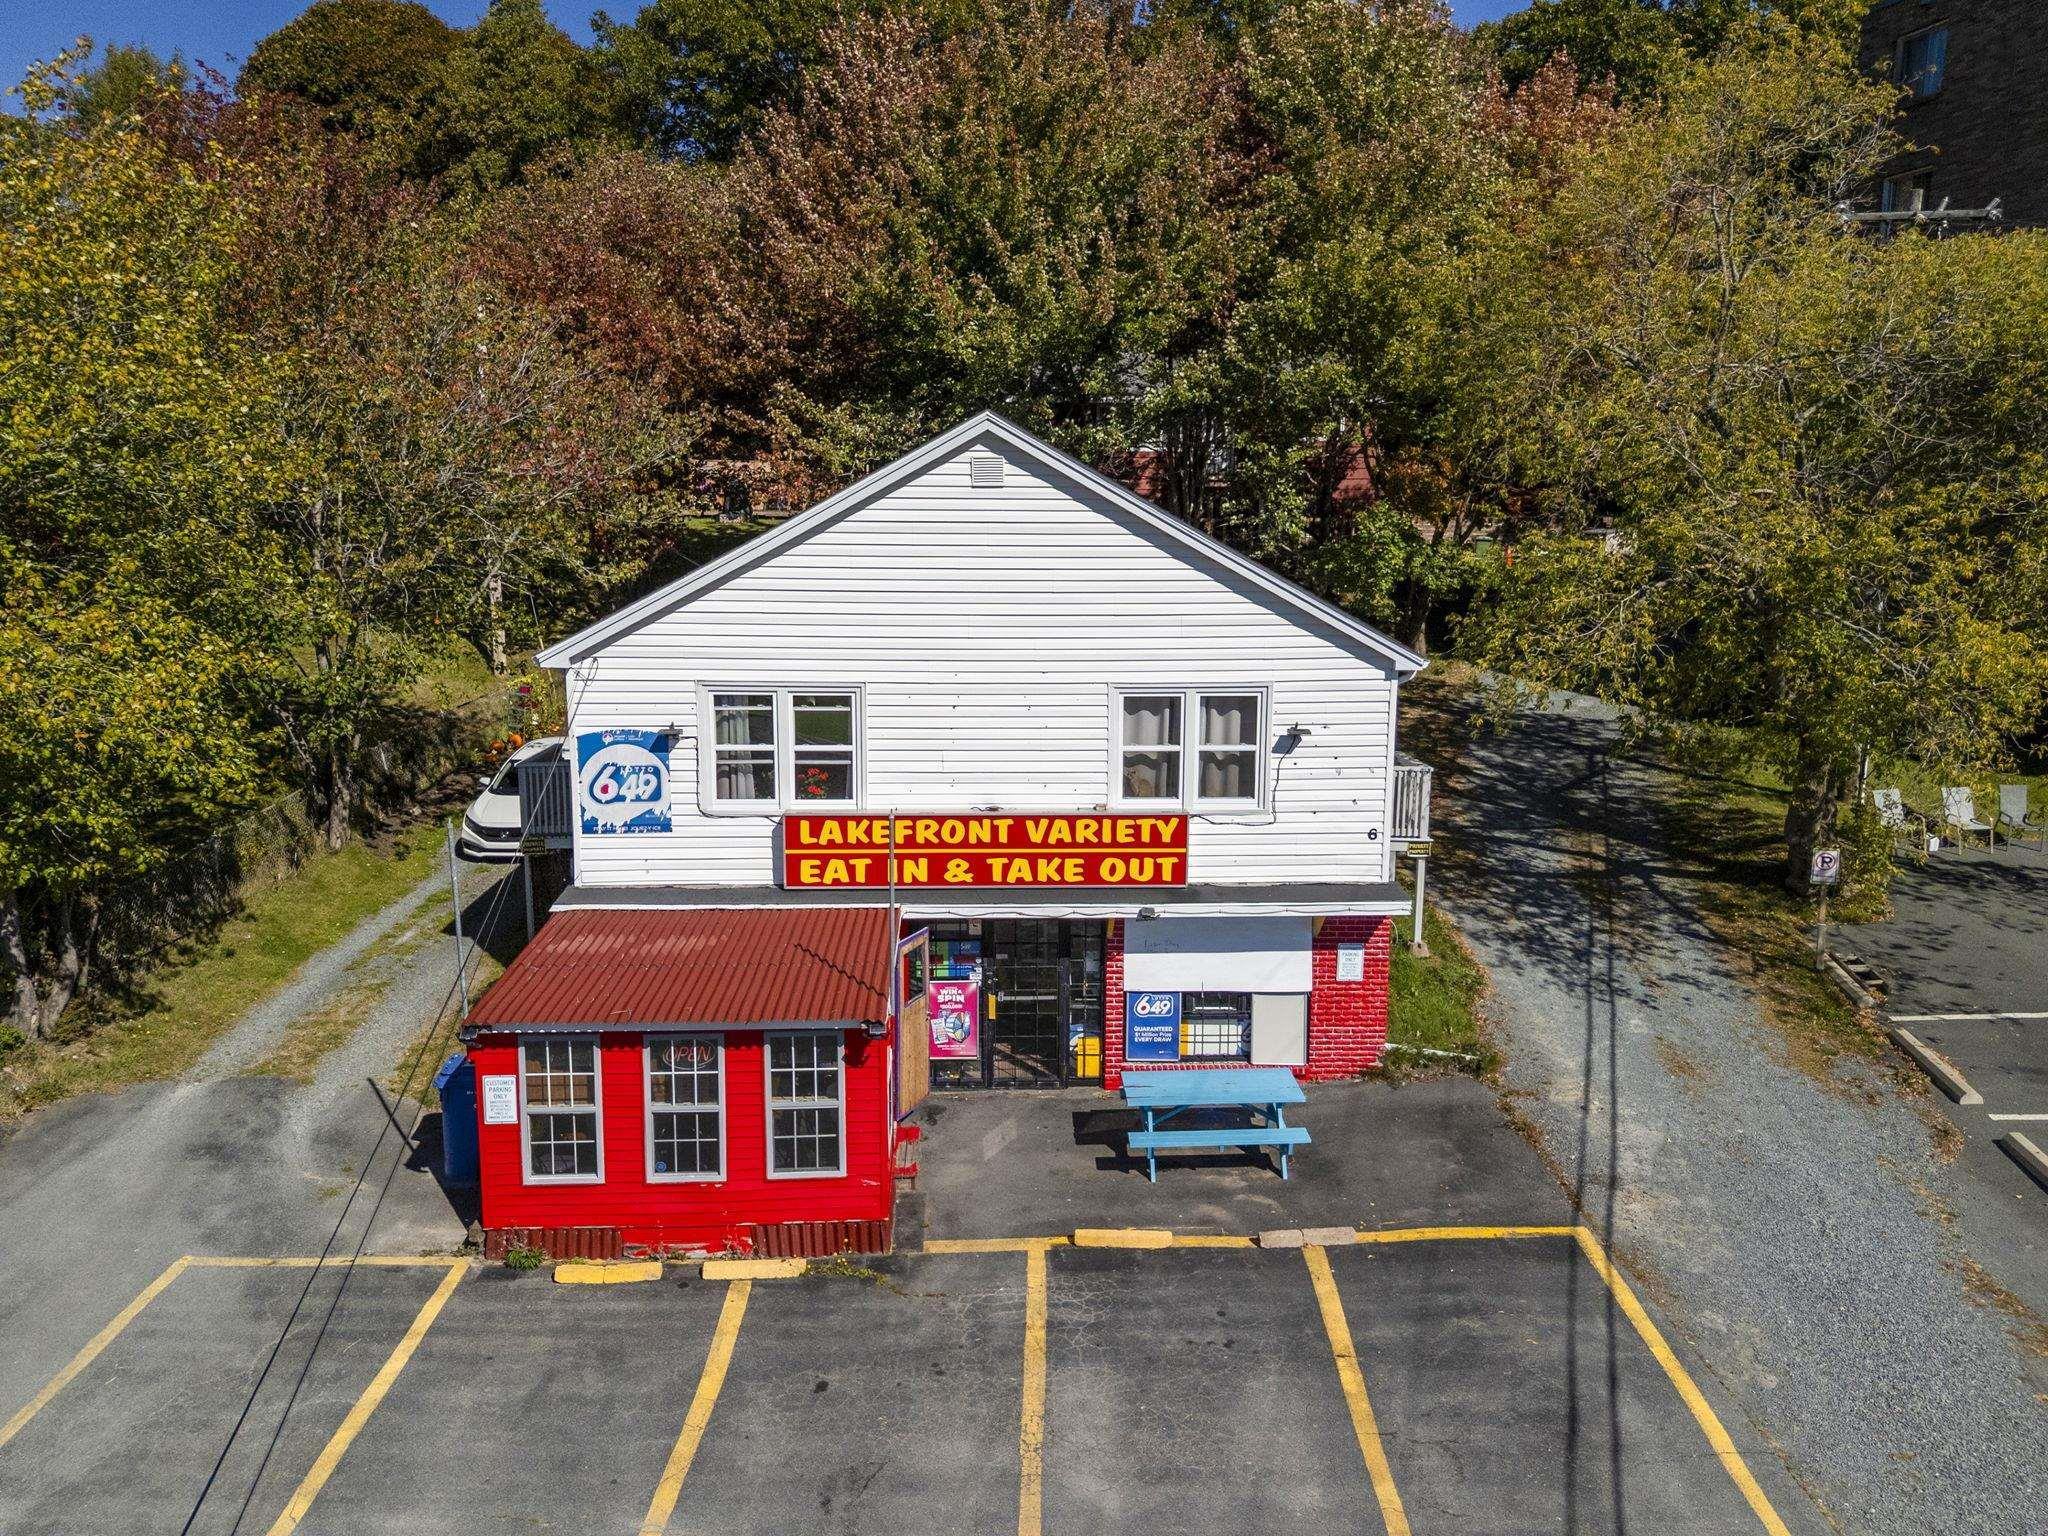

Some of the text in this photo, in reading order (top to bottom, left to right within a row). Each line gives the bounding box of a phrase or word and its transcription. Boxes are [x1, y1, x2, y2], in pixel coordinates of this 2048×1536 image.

[620, 766, 654, 774] LOTTO
[799, 817, 1179, 845] LAKEFRONT VARIETY
[1367, 828, 1377, 840] 6
[799, 856, 1179, 885] EAT IN & TAKE OUT
[937, 994, 965, 1003] SPIN
[665, 1046, 711, 1062] OPEN
